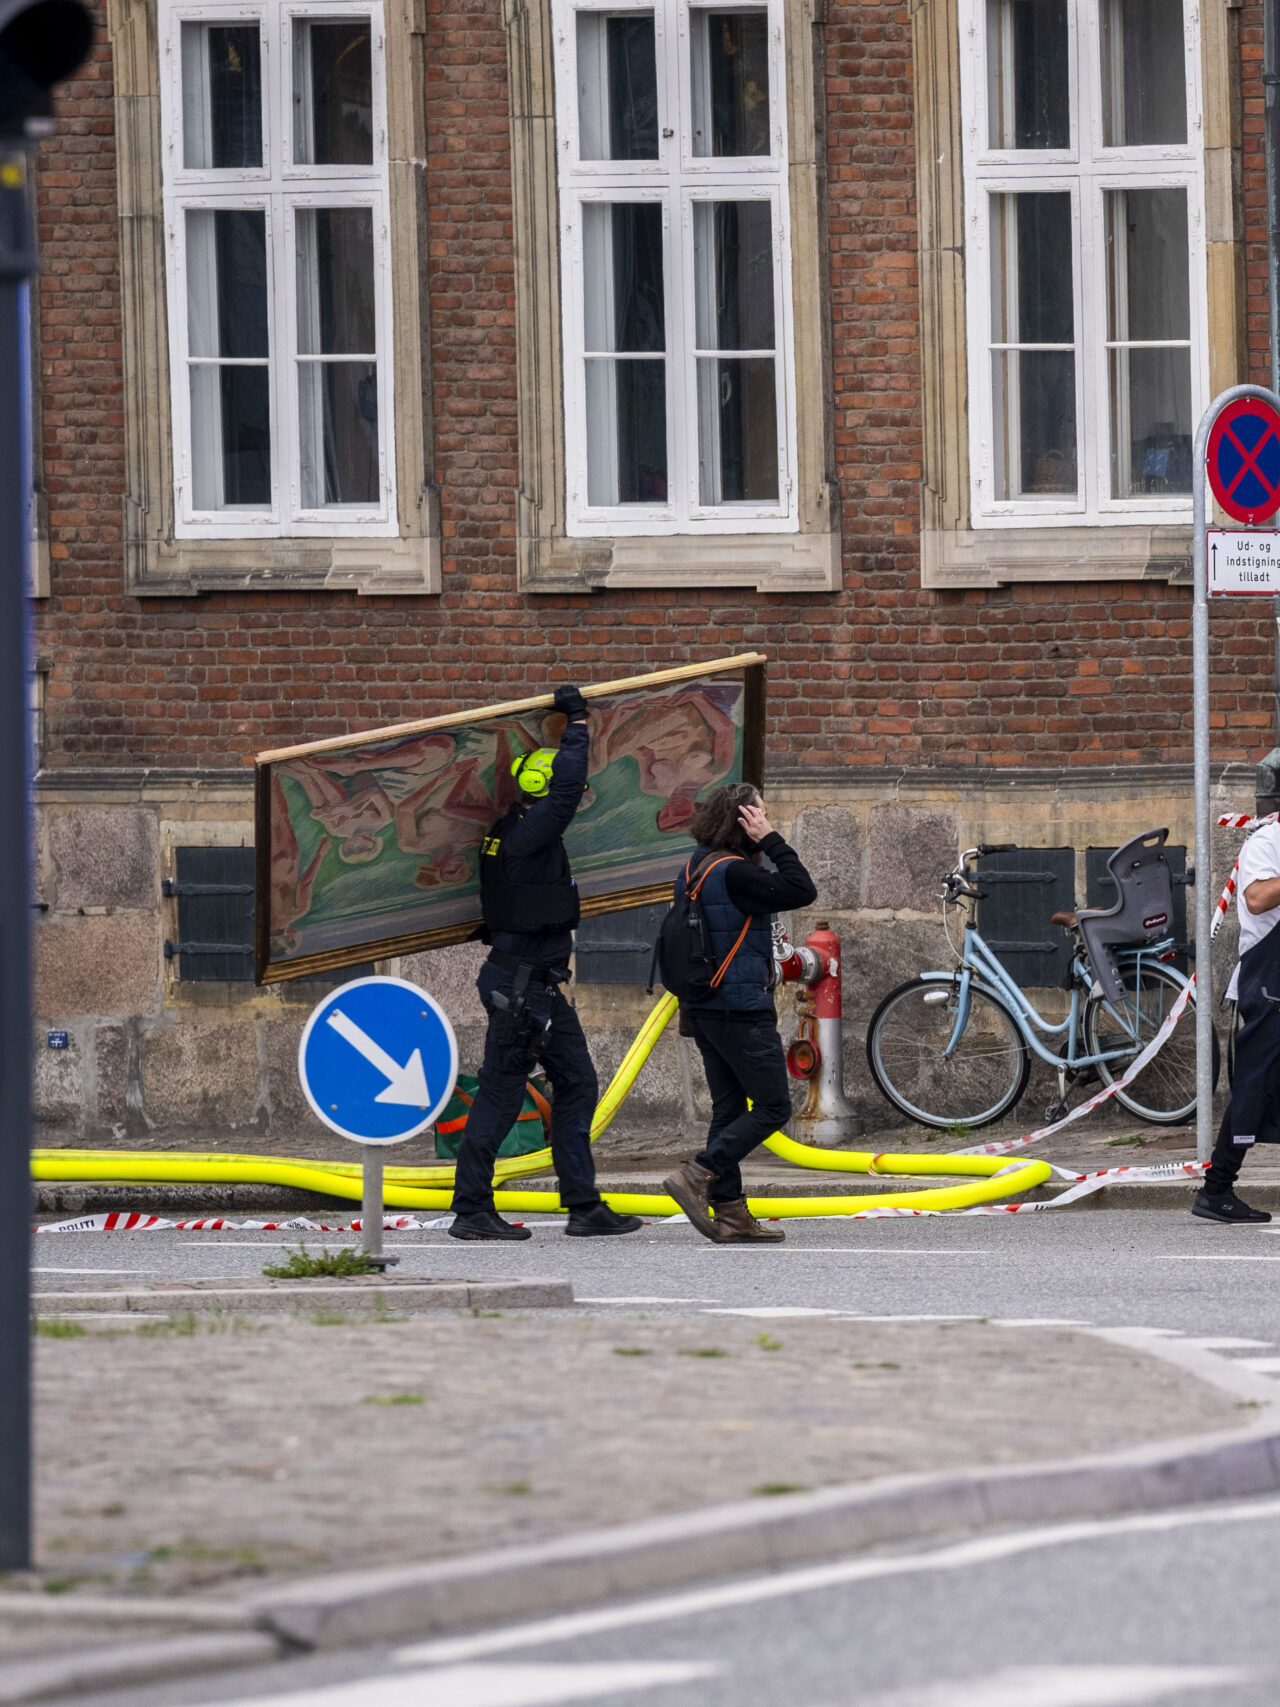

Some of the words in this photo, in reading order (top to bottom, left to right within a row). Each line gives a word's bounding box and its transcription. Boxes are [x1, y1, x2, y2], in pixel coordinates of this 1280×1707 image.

[1237, 540, 1254, 551] Ud-
[1259, 543, 1271, 553] og
[1239, 572, 1270, 582] tilladt
